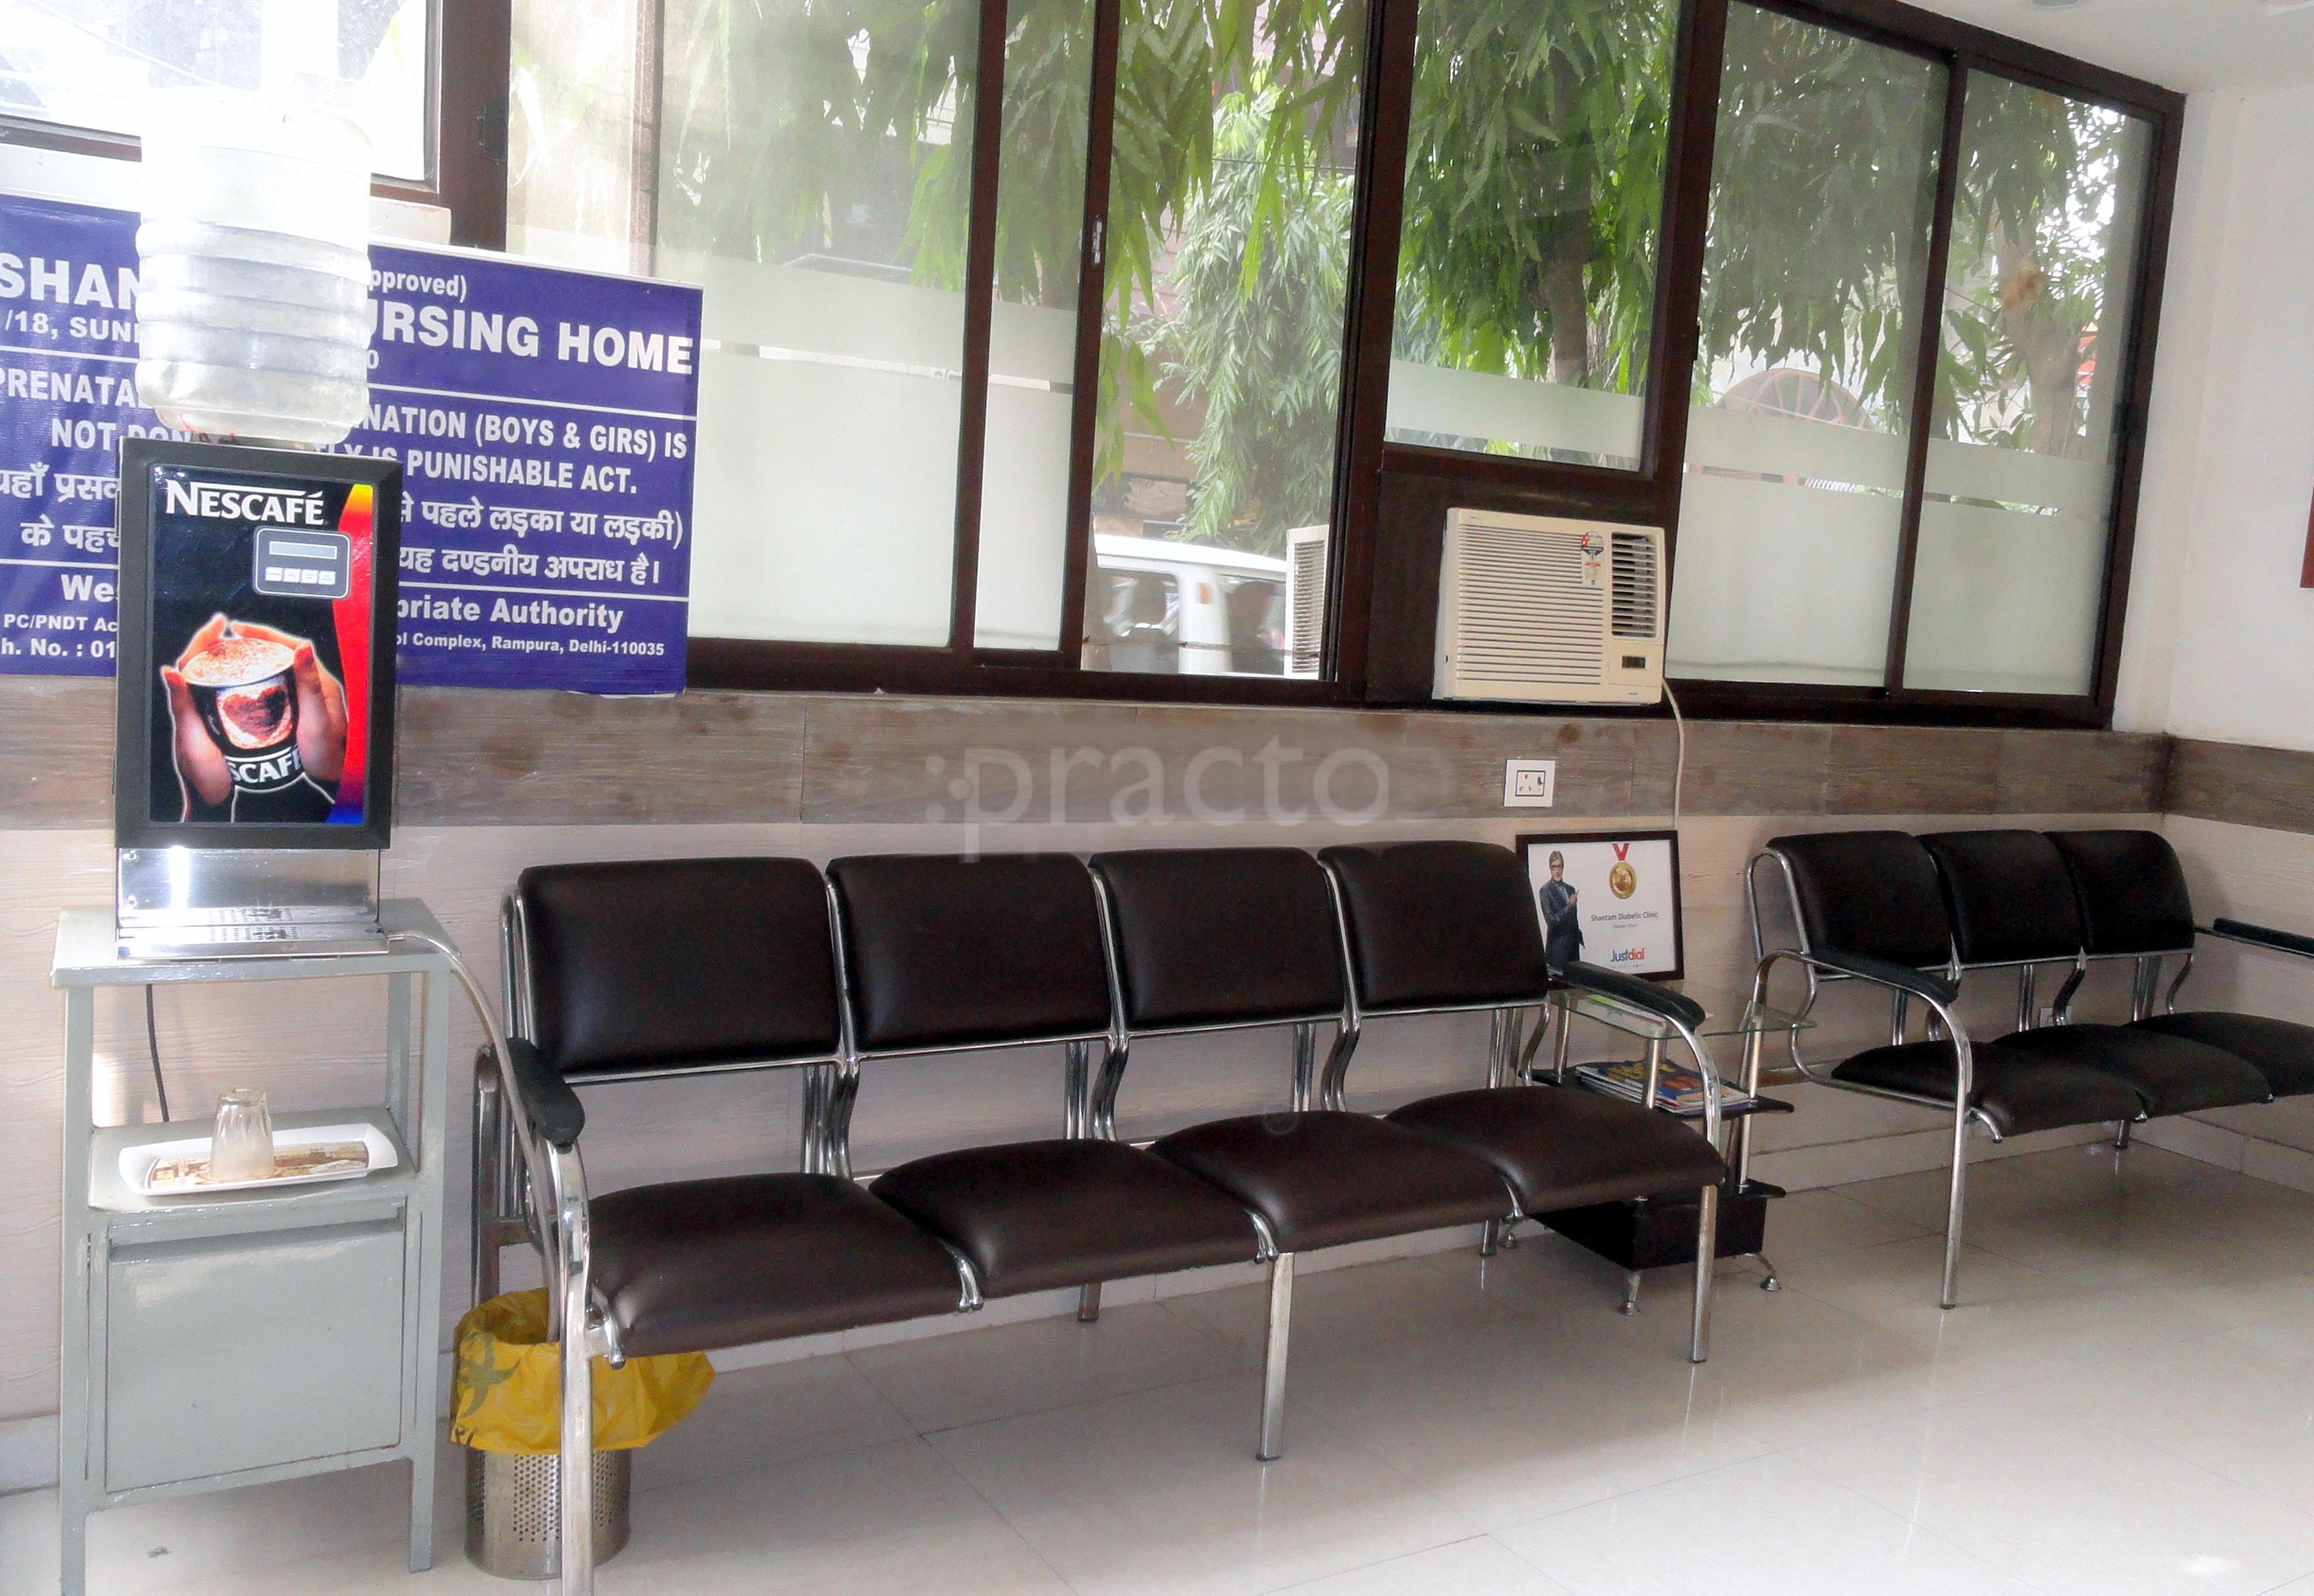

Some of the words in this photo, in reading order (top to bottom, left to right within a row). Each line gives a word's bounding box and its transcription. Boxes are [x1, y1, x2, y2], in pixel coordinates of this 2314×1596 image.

[5, 309, 58, 340] /18,
[70, 317, 139, 343] SUN
[558, 322, 693, 375] HOME
[52, 418, 116, 451] NOT
[353, 404, 466, 439] NATION
[475, 414, 554, 447] (BOYS
[563, 422, 580, 449] &
[590, 427, 655, 461] GIRS)
[664, 431, 687, 459] IS
[407, 449, 573, 489] PUNISHABLE
[580, 466, 637, 494] ACT.
[20, 513, 55, 546] के
[421, 496, 484, 528] पहले
[489, 506, 564, 538] लड़का
[570, 512, 598, 535] या
[603, 510, 683, 550] लड़की)
[442, 544, 539, 576] दण्डनीय
[544, 556, 625, 581] अपराध
[61, 574, 118, 603] We
[4, 614, 88, 630] PC/PNDT
[490, 598, 624, 633] Authority
[31, 638, 68, 656] No.
[413, 633, 486, 651] Complex,
[492, 636, 564, 654] Rampura,
[569, 639, 664, 656] Delhi-110035
[1611, 947, 1645, 962] Justdial
